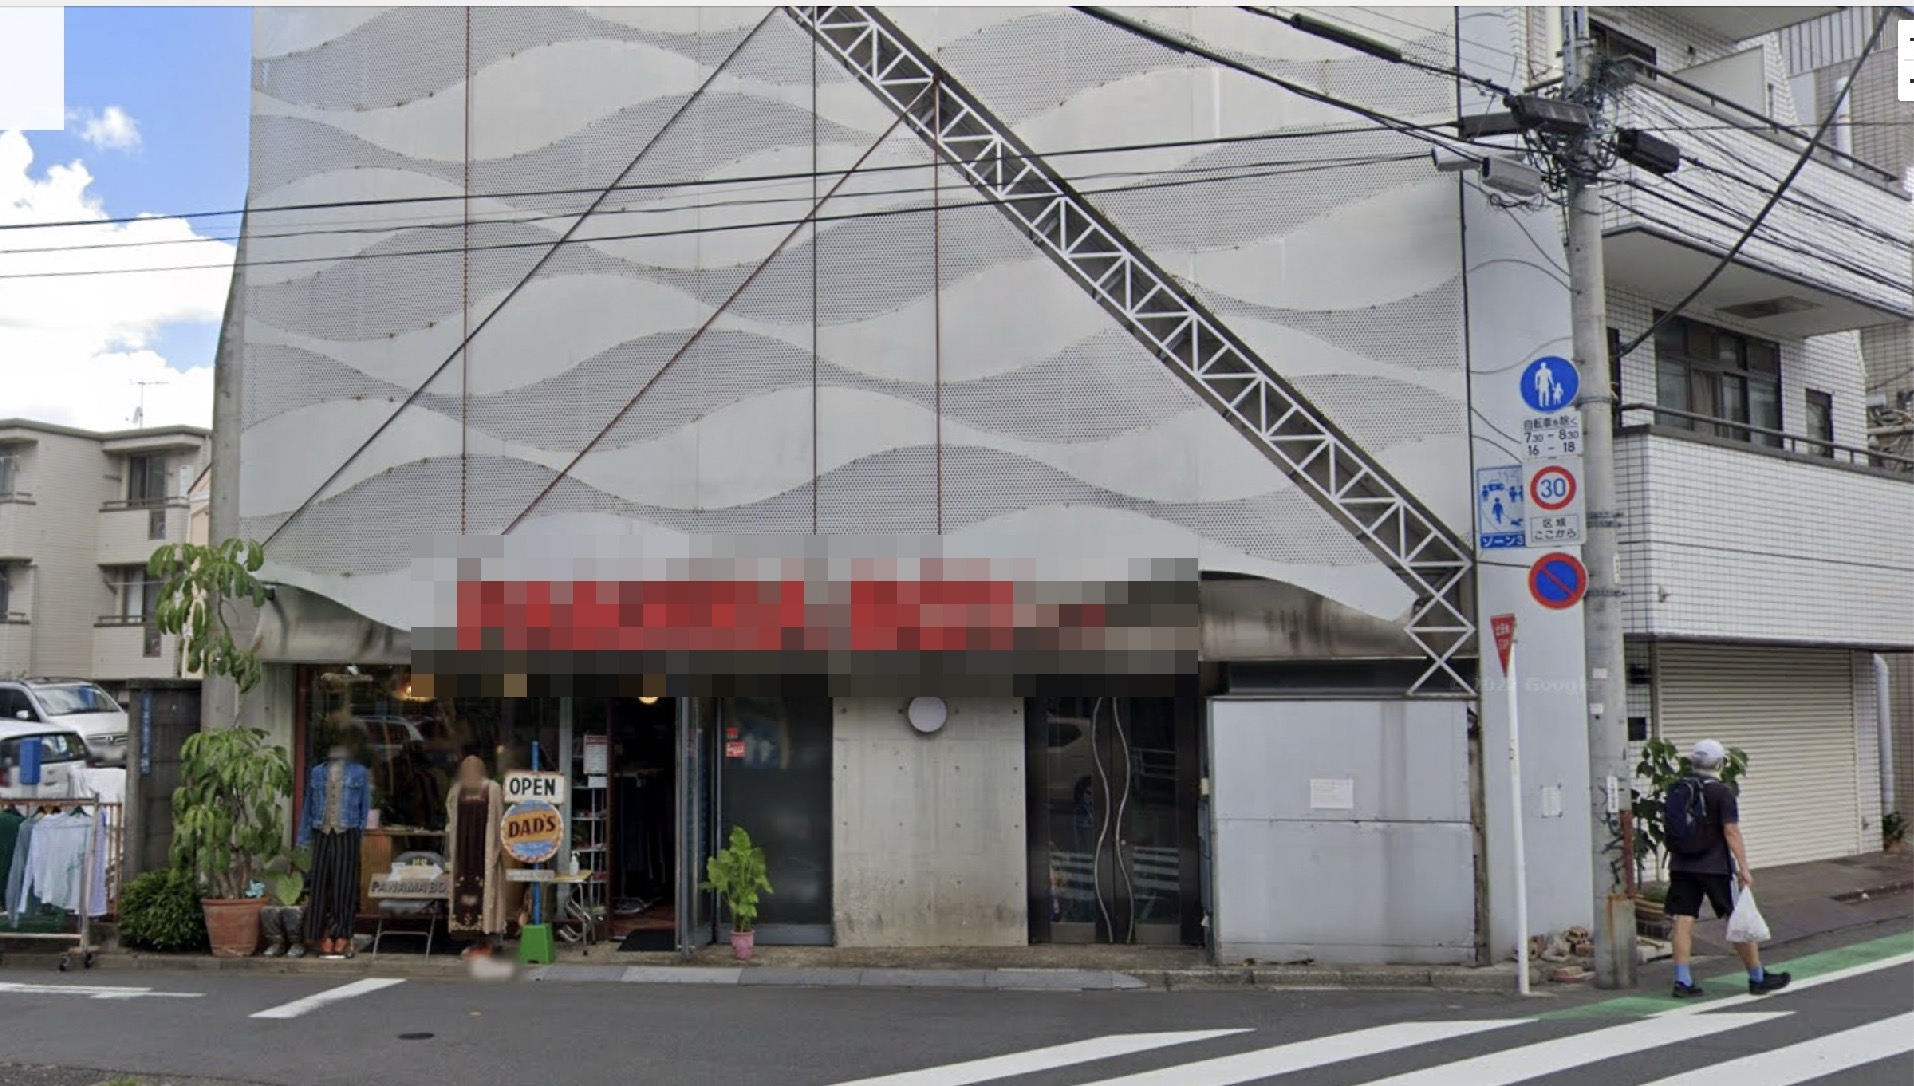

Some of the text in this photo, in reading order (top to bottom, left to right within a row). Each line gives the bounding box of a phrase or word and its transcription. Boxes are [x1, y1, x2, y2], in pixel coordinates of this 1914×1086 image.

[1524, 416, 1578, 430] 自転車を除く
[1528, 444, 1540, 456] 16
[1563, 442, 1575, 453] 18
[1540, 478, 1566, 498] 30
[1534, 528, 1577, 540] ここから
[509, 777, 556, 796] OPEN
[508, 814, 557, 838] DAD'S
